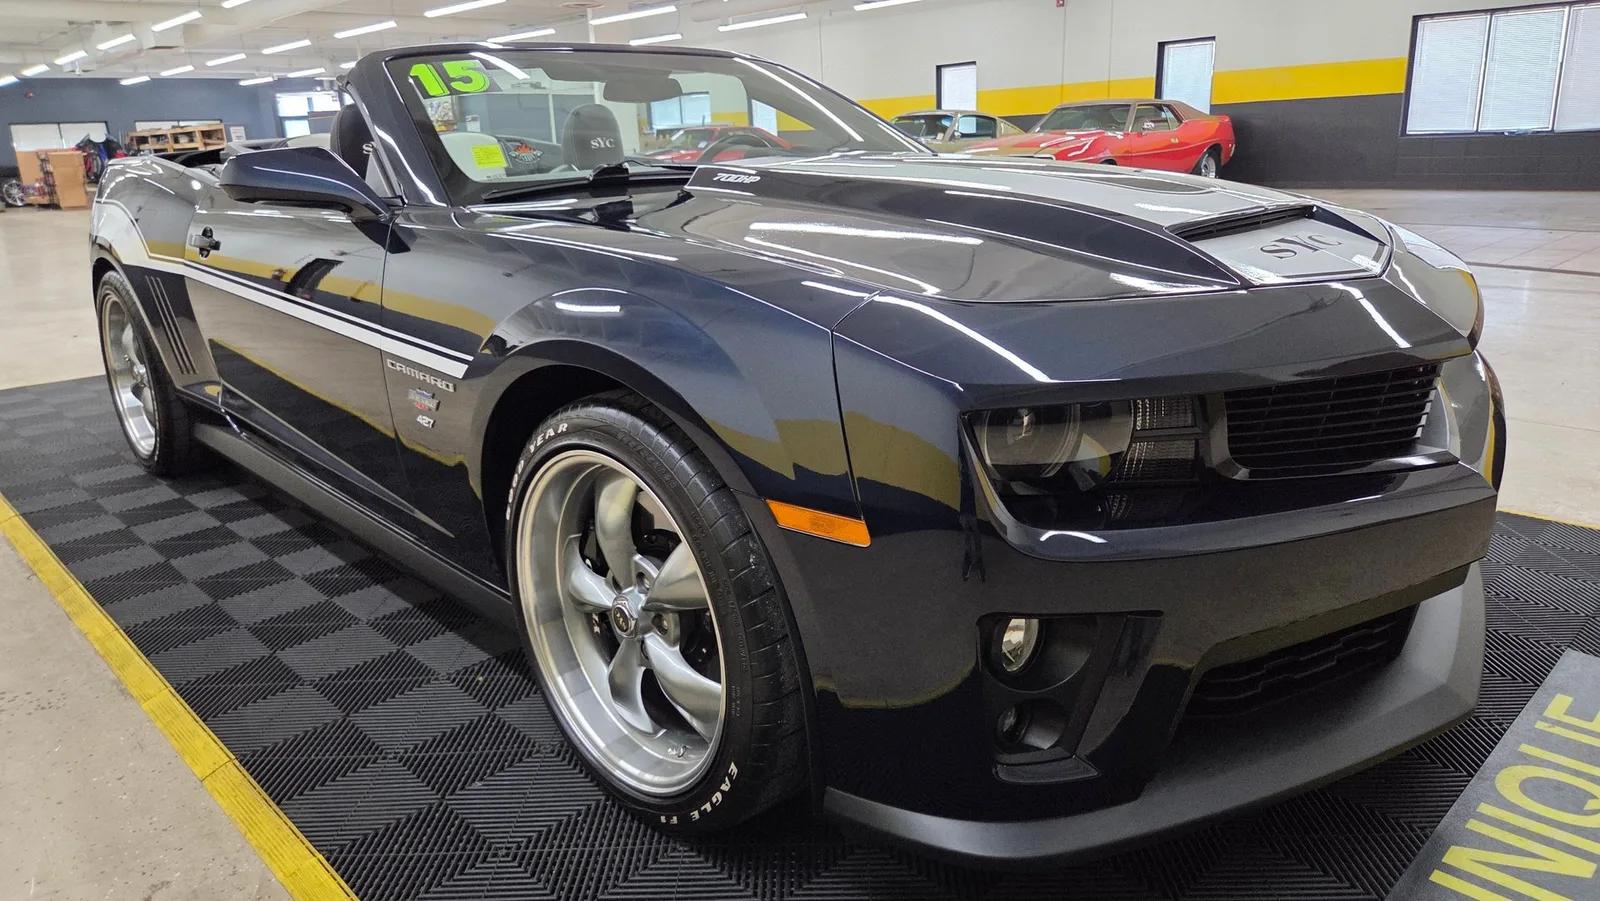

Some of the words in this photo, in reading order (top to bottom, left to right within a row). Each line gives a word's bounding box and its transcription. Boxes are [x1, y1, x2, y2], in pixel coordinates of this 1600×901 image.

[410, 60, 490, 97] 15
[590, 137, 615, 149] SYC
[712, 172, 761, 184] 700HP
[1260, 234, 1343, 259] SYC
[387, 359, 455, 393] CAMARO
[416, 414, 435, 429] 427
[689, 761, 739, 822] EAGLE
[1428, 693, 1600, 901] NIQU
